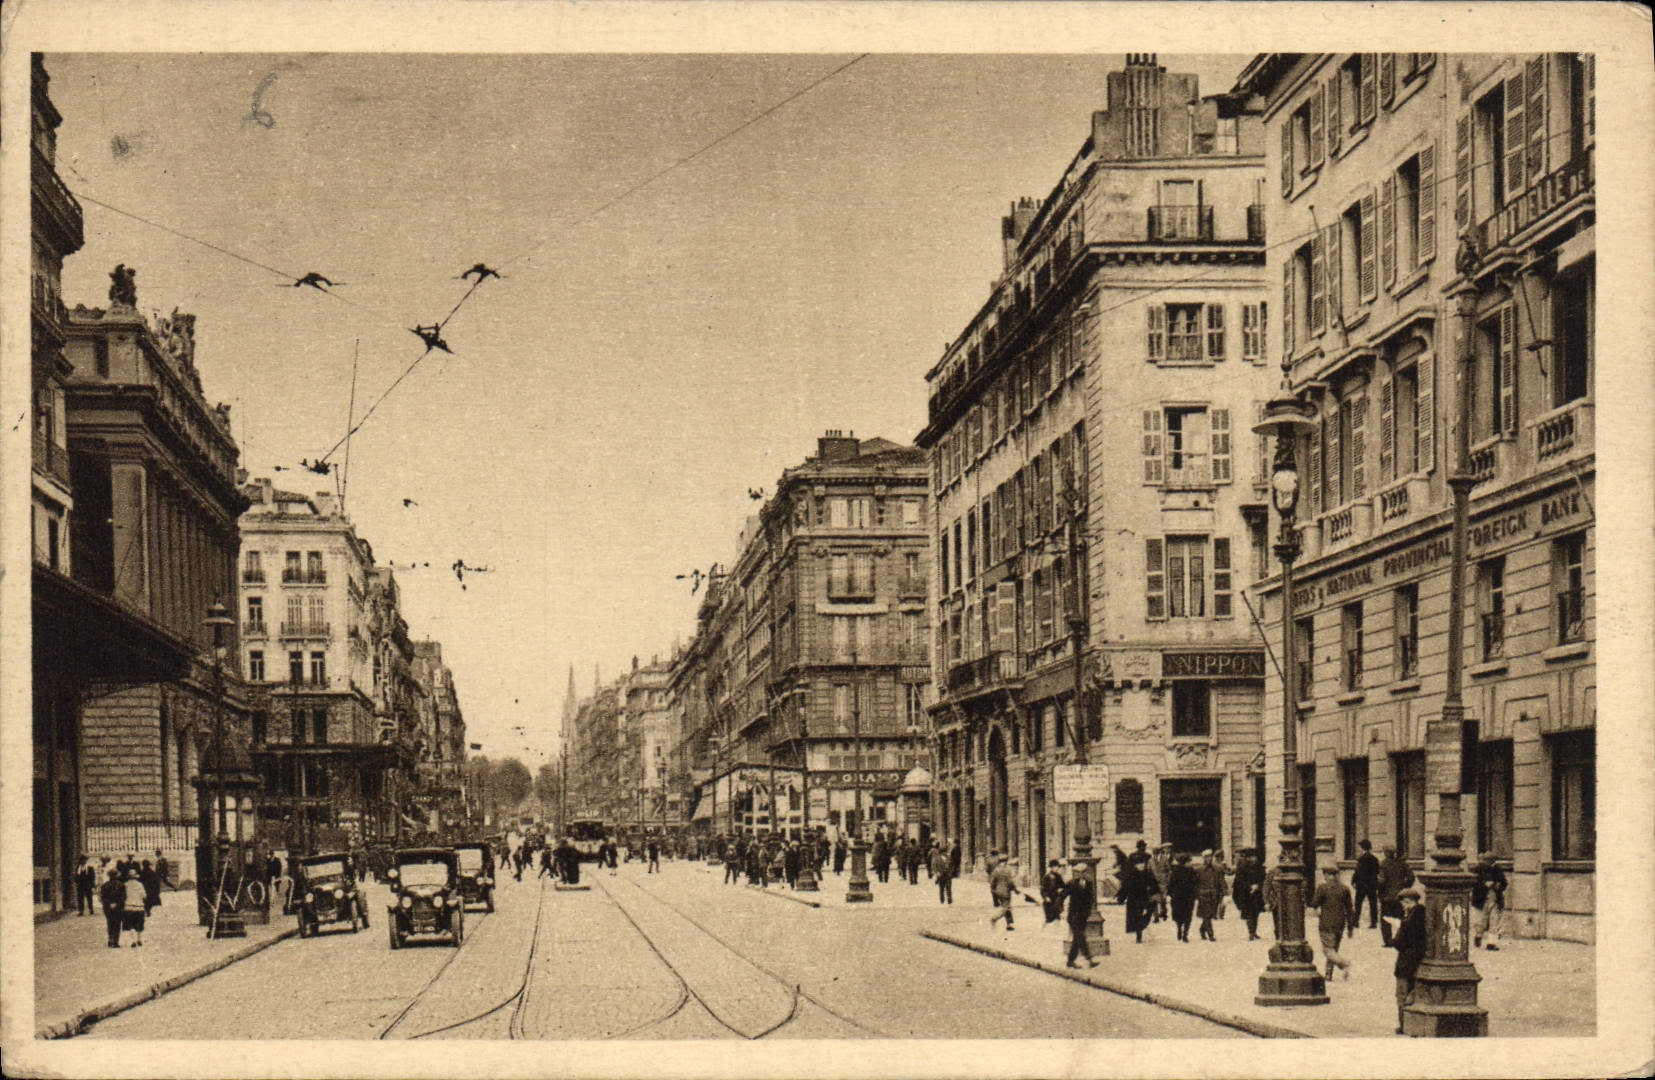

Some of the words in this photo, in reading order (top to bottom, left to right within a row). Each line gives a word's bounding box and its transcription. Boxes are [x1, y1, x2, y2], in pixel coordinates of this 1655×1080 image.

[1383, 536, 1452, 577] PROVINCIAL
[1466, 510, 1527, 546] FOREIGN
[1541, 491, 1580, 525] BANK
[1178, 654, 1261, 675] NIPPON
